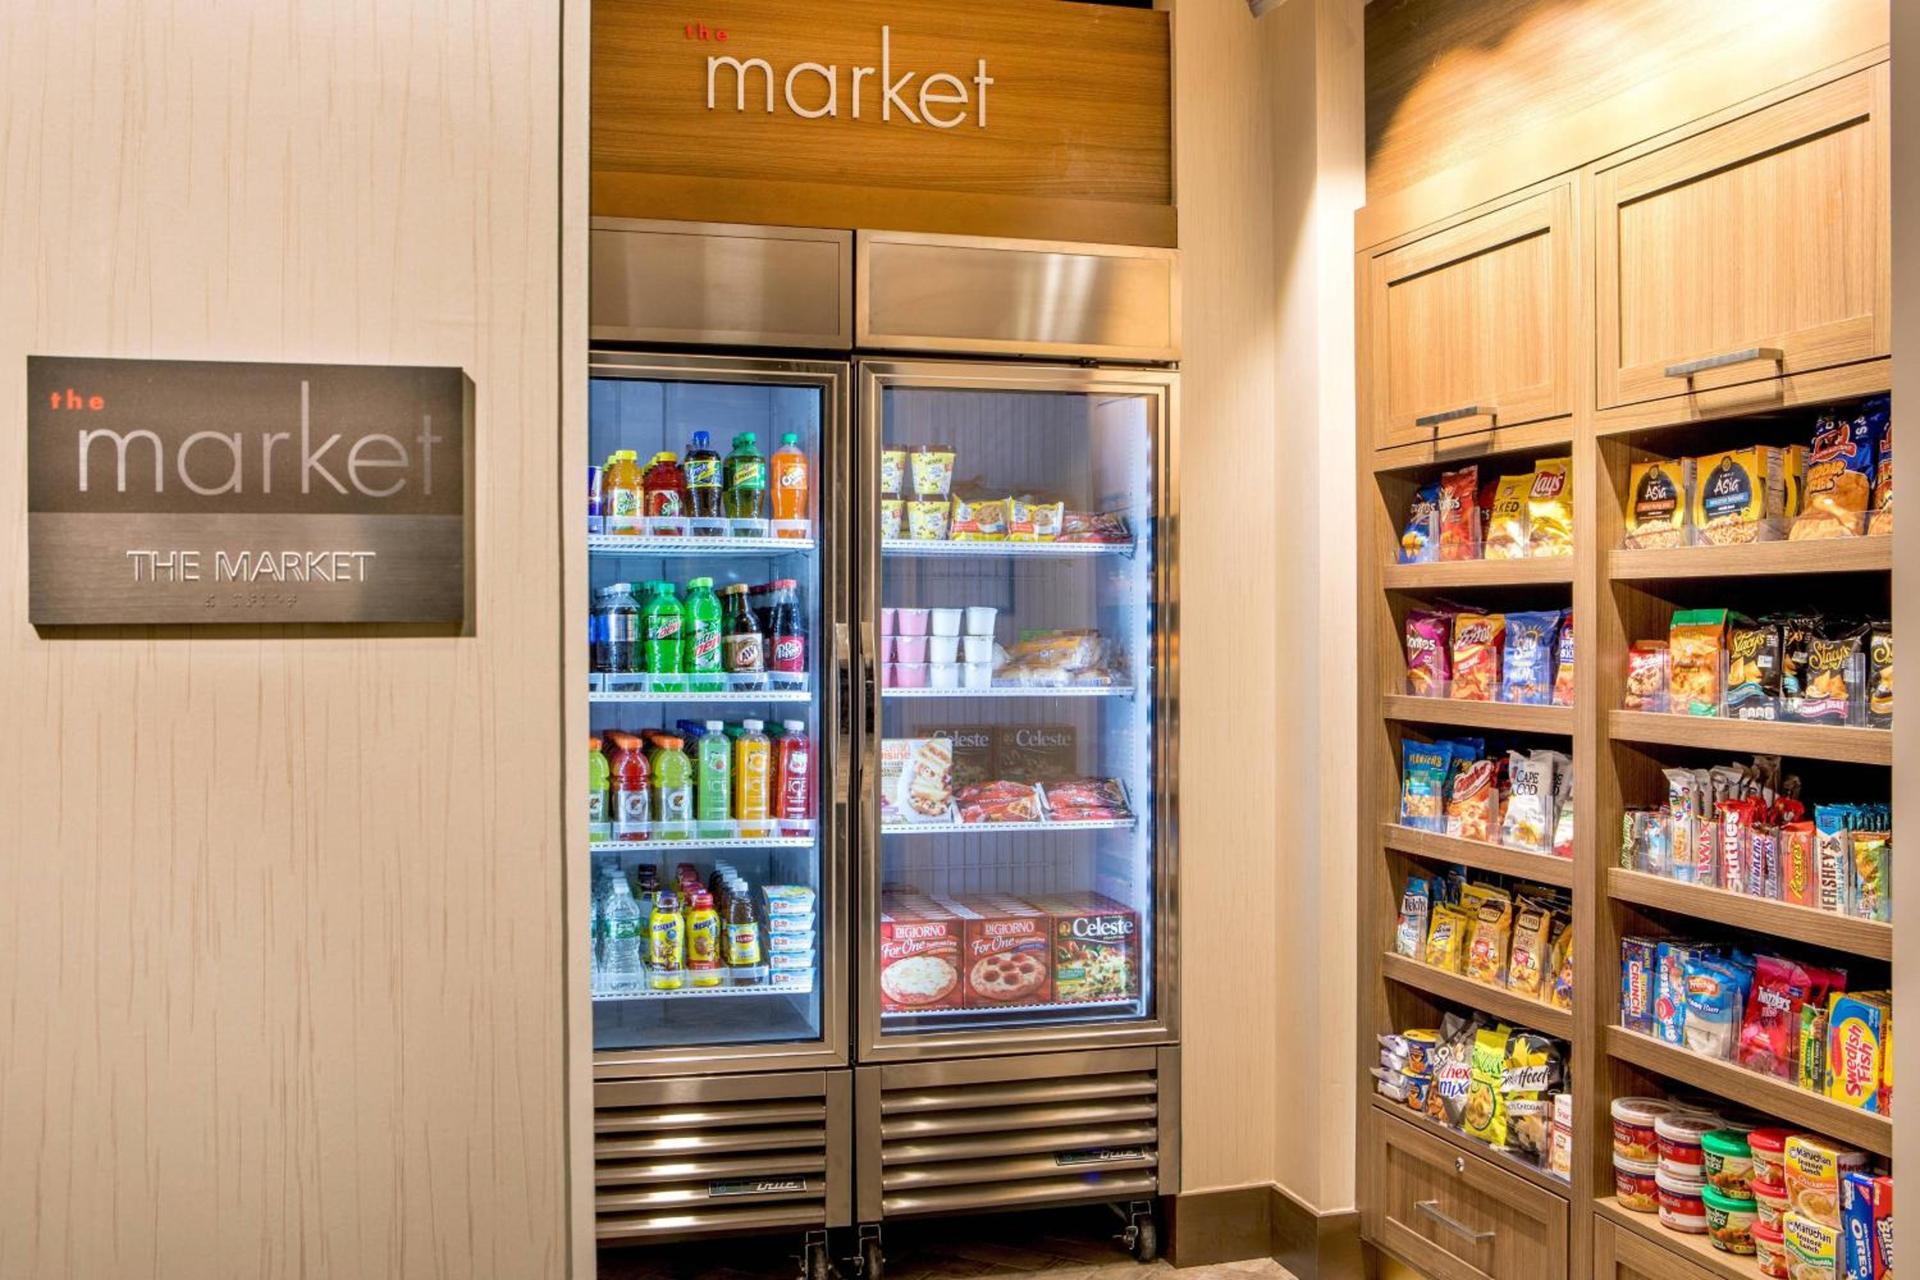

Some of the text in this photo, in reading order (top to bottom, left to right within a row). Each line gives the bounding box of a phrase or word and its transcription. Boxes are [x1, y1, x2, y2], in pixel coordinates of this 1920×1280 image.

[684, 23, 729, 42] the
[707, 24, 995, 128] market
[50, 388, 106, 411] the
[78, 380, 443, 498] market
[1713, 478, 1742, 495] Asia
[126, 550, 376, 583] THE MARKET
[1734, 631, 1766, 656] Stacy's
[1809, 641, 1852, 669] Stacy's
[1015, 728, 1072, 747] Celeste
[1517, 770, 1540, 784] CAPE
[1517, 783, 1538, 796] COD
[1073, 916, 1133, 937] Celeste
[902, 937, 926, 955] One
[992, 935, 1014, 952] One
[1630, 961, 1642, 1016] CRUNCH
[1845, 1023, 1863, 1097] Swedish
[1858, 1042, 1873, 1084] Fish
[1796, 1147, 1832, 1166] Maruchan
[1800, 1166, 1821, 1177] Lunch
[1794, 1221, 1832, 1245] Maruchan
[1799, 1240, 1820, 1255] Lunch
[1851, 1218, 1868, 1278] OREO
